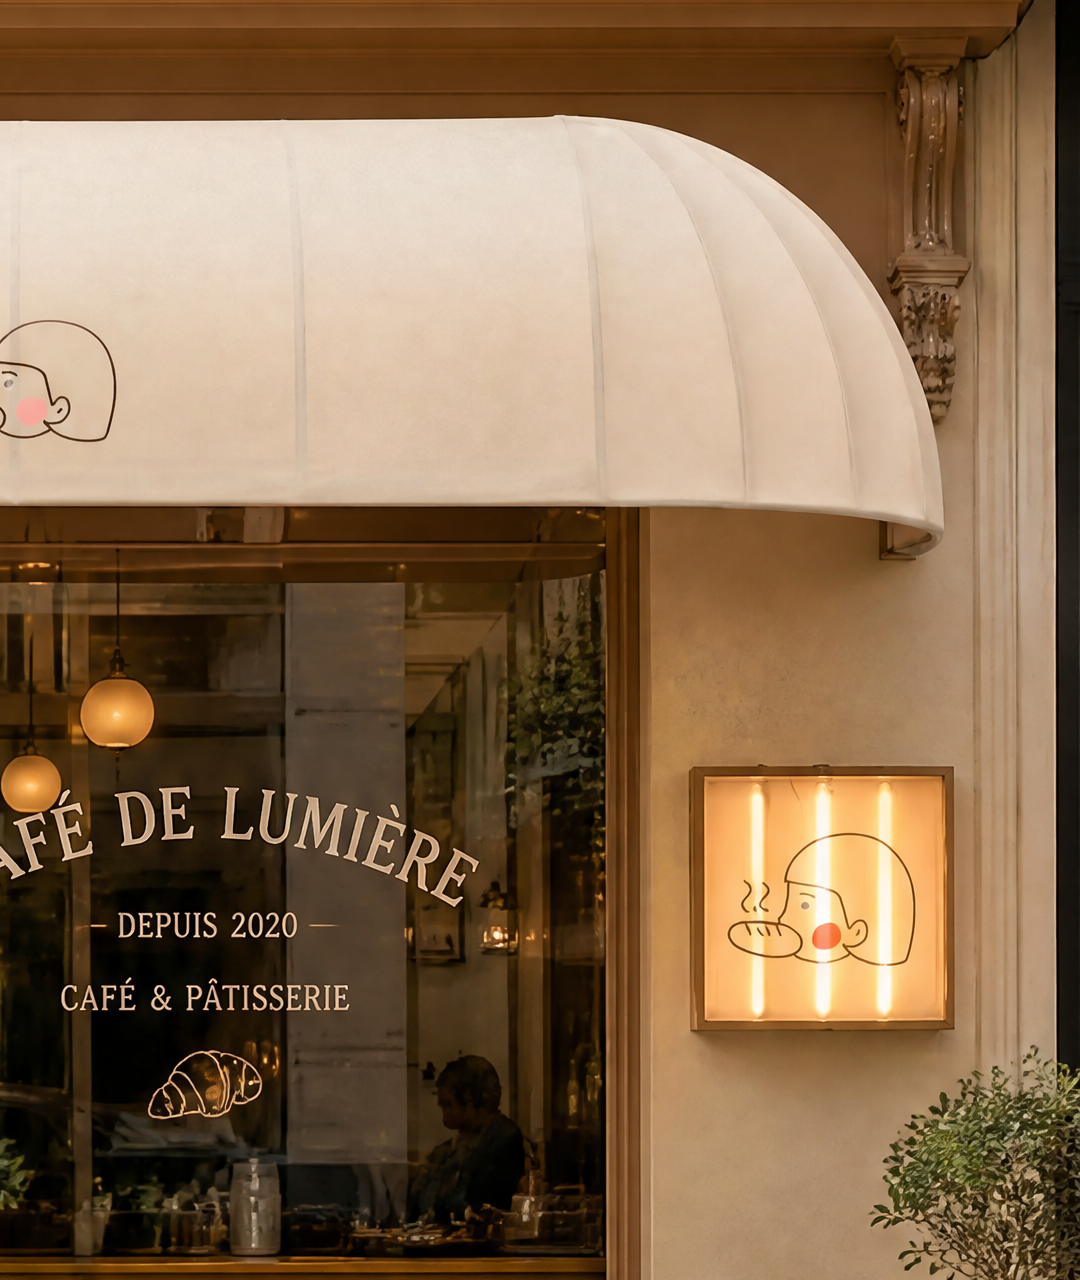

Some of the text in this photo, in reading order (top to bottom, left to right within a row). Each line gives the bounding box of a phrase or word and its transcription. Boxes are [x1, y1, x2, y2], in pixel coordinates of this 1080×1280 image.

[114, 785, 195, 847] DE
[220, 786, 480, 908] LUMIÈRE
[117, 911, 299, 939] DEPUIS 2020
[60, 977, 350, 1012] CAFÉ & PÂTISSERIE
